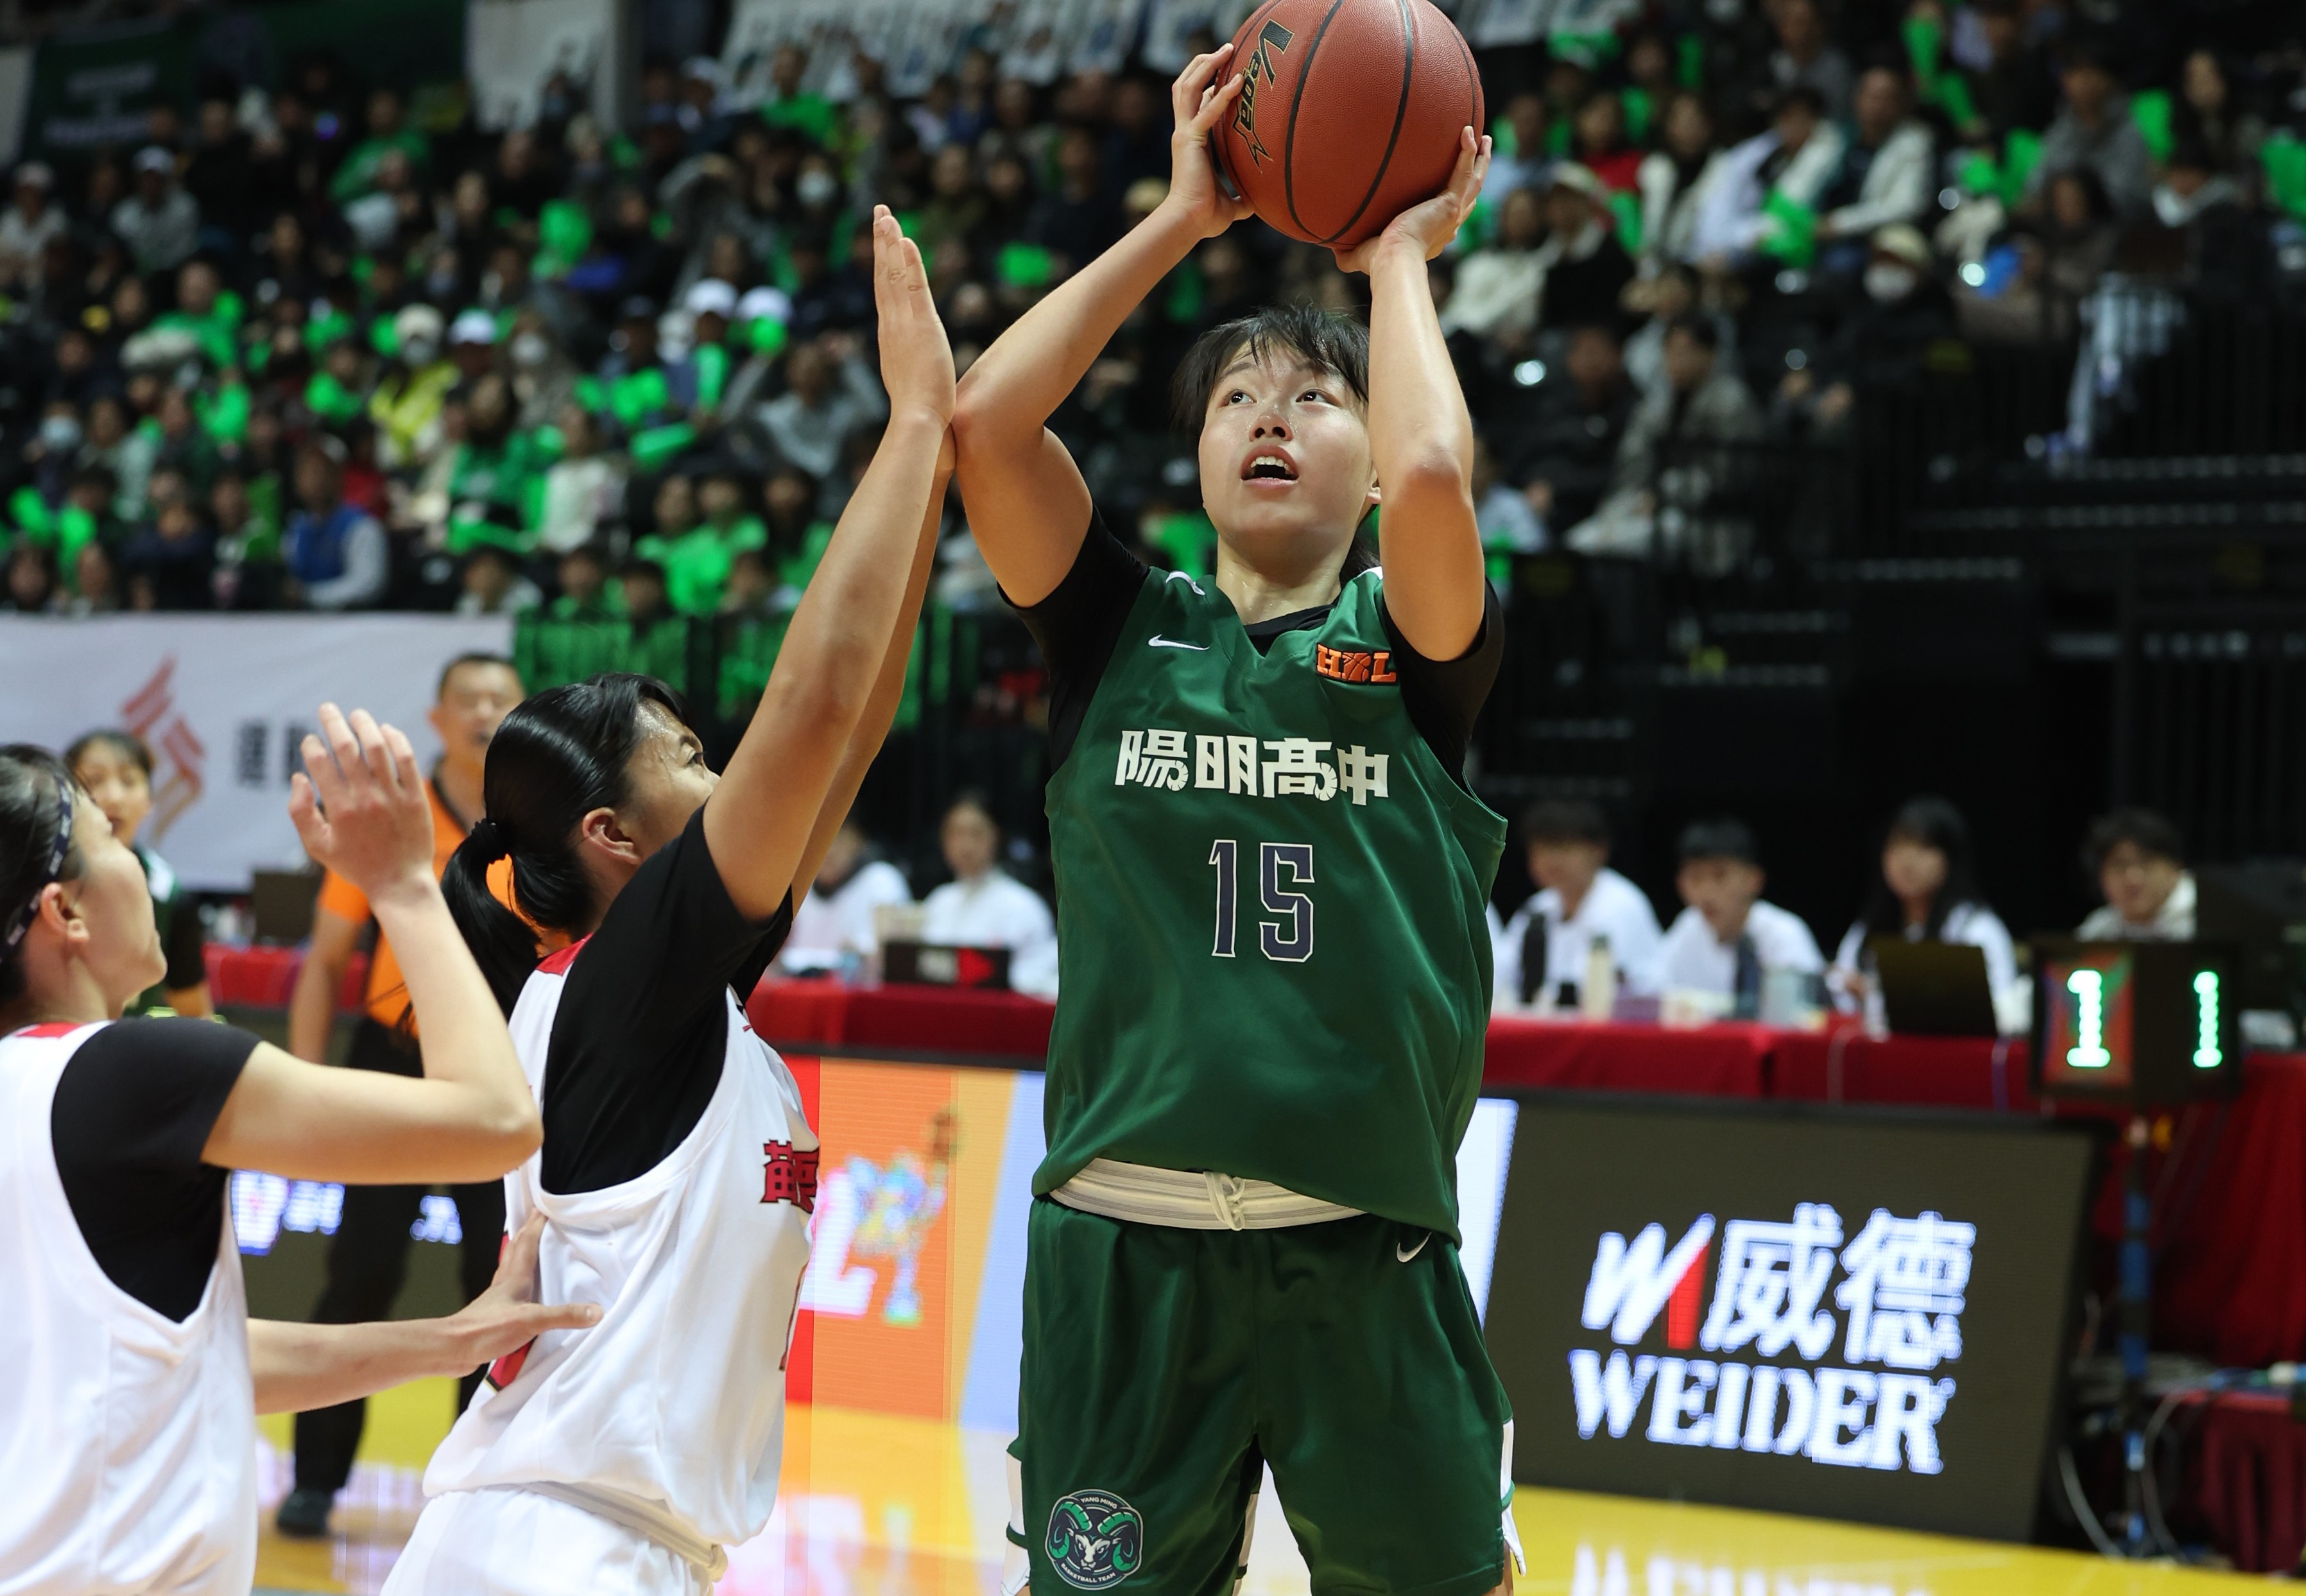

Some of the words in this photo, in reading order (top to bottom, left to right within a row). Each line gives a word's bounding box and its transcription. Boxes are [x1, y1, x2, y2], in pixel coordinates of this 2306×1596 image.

[1237, 19, 1295, 136] Vega
[1114, 728, 1390, 806] 陽明高中
[1208, 839, 1315, 963] 15
[2067, 970, 2111, 1068] 1
[1568, 1349, 1956, 1475] WEIDER
[1100, 1498, 1117, 1509] MING
[1061, 1563, 1097, 1583] BASKETBALL
[1098, 1572, 1116, 1583] TEAM
